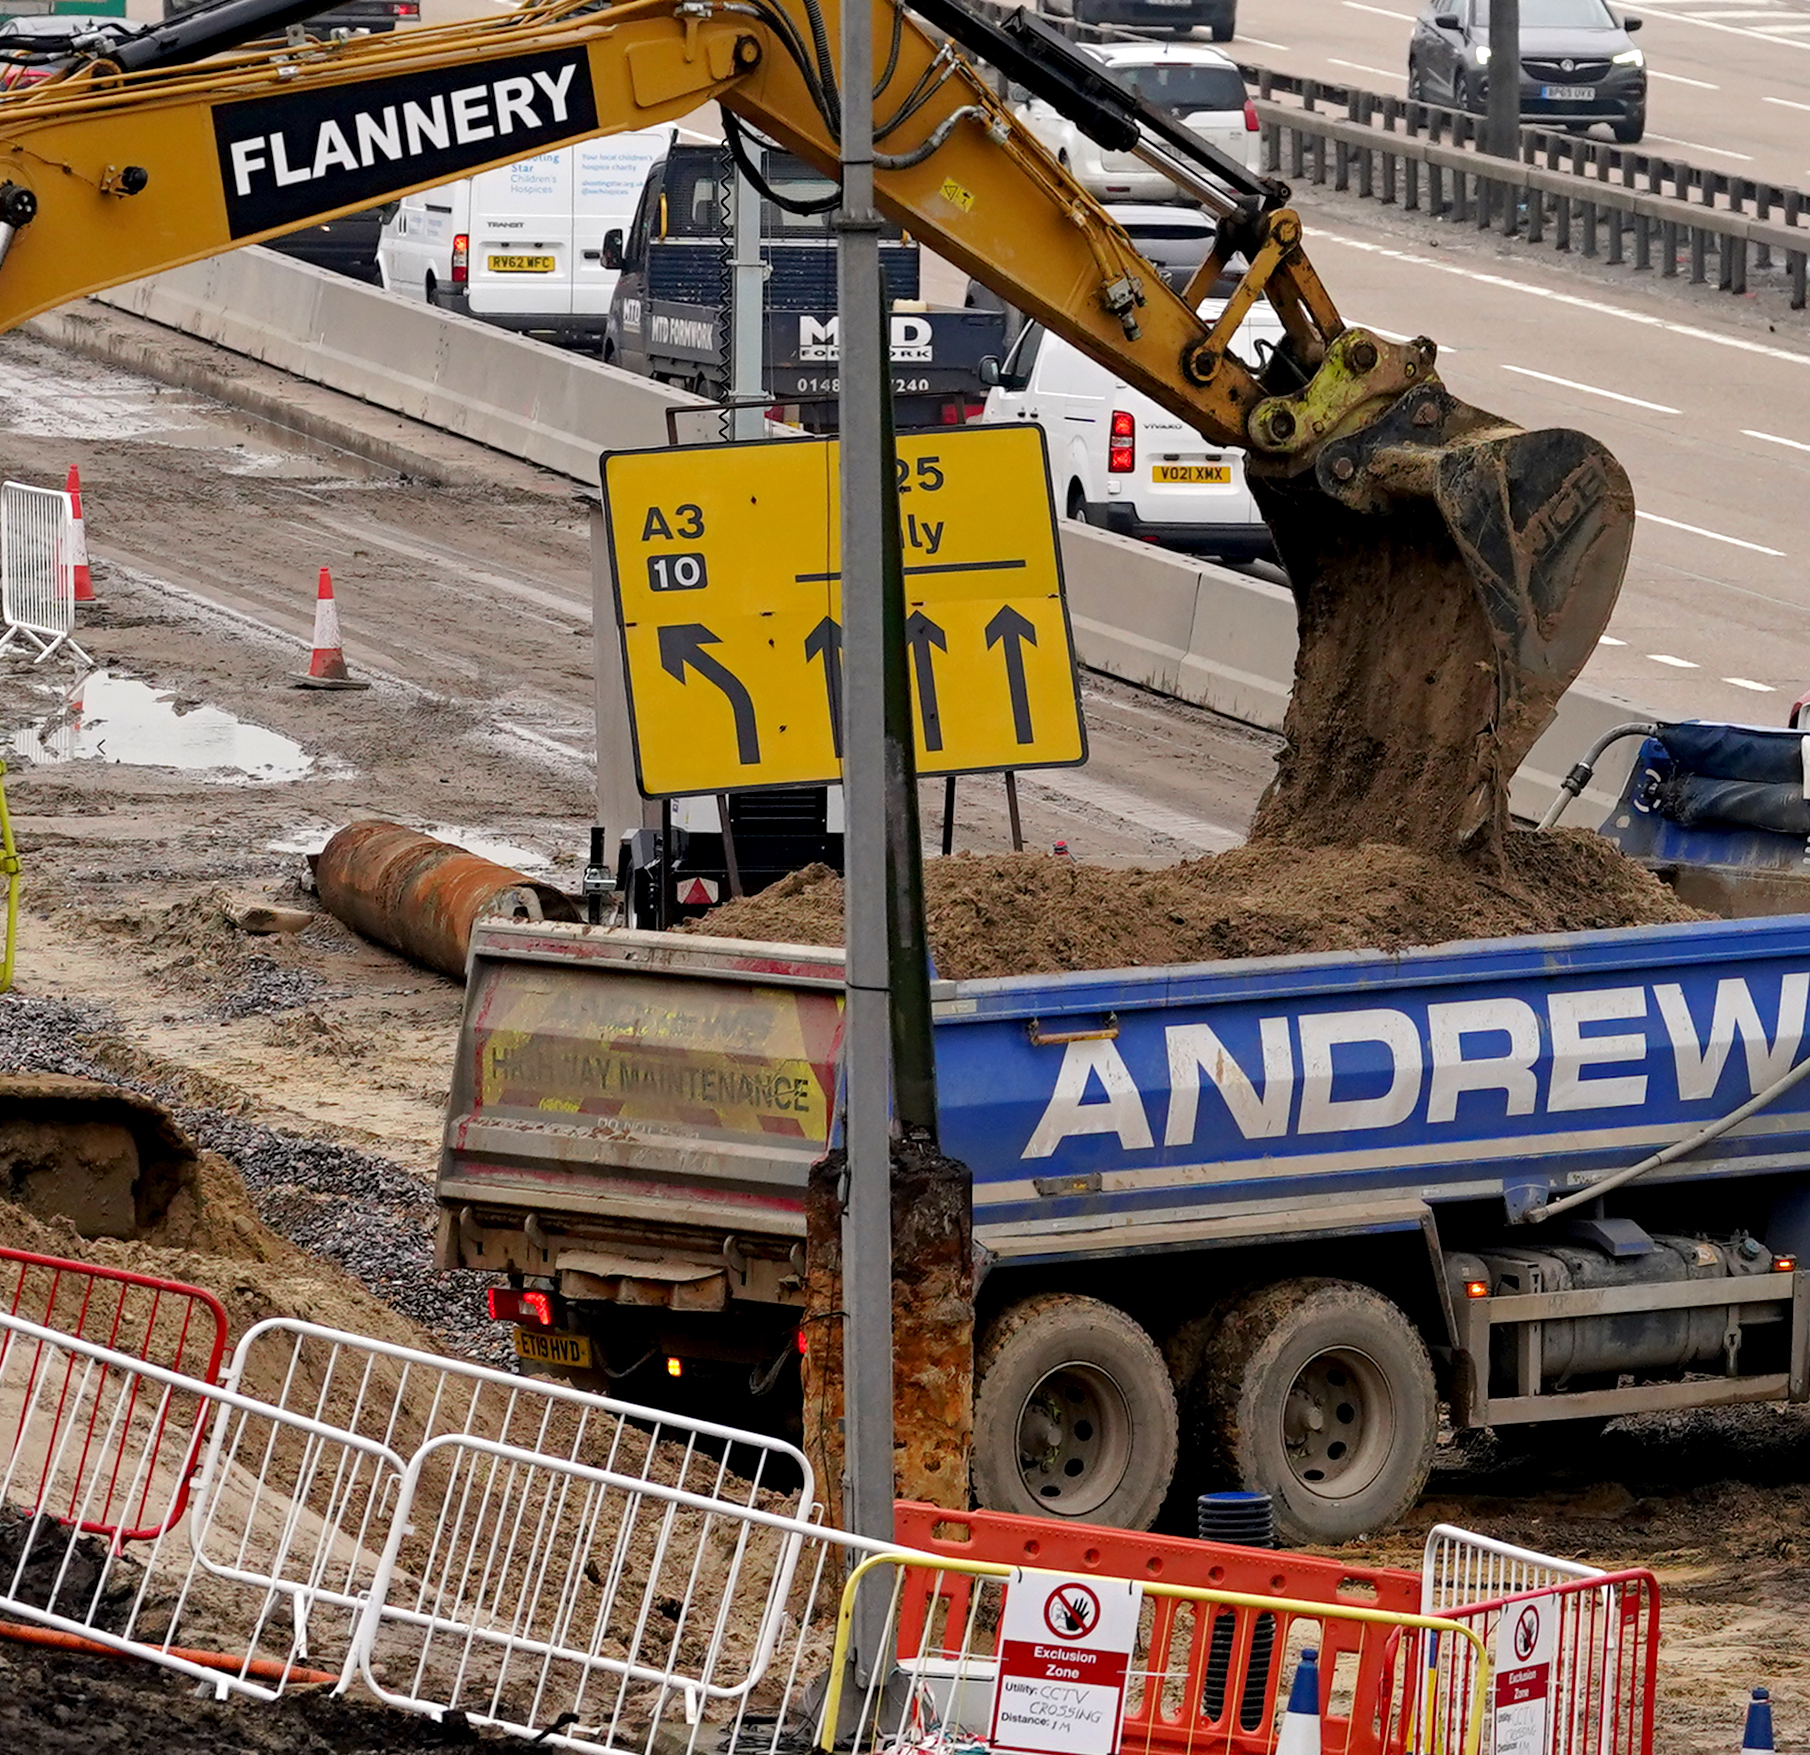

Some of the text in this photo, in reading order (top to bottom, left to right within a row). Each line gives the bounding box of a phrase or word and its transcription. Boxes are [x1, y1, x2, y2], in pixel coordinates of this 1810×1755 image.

[230, 64, 577, 196] FLANNERY
[581, 153, 654, 161] Your local children's
[511, 163, 533, 173] Star
[581, 163, 637, 173] hospice charity
[510, 174, 557, 184] Children's
[510, 185, 553, 195] Hospices
[487, 221, 525, 229] TRANSIT
[492, 255, 550, 268] RV62 WFC
[651, 315, 714, 351] MTD FORMWORK
[799, 315, 933, 347] MD
[1160, 466, 1223, 481] VO21 XMX
[641, 503, 705, 542] A3
[652, 555, 702, 589] 10
[618, 1061, 811, 1113] MAINTENANCE
[521, 1333, 581, 1358] ET19 HVD
[1033, 1645, 1097, 1664] Exclusion
[1045, 1663, 1080, 1679] Zone
[1508, 1669, 1537, 1685] Exclusion
[1005, 1682, 1038, 1695] Utility:
[1040, 1685, 1091, 1704] CCTV
[1513, 1687, 1530, 1700] Zone
[1001, 1711, 1050, 1726] Distance:
[1029, 1701, 1103, 1724] CROSSING
